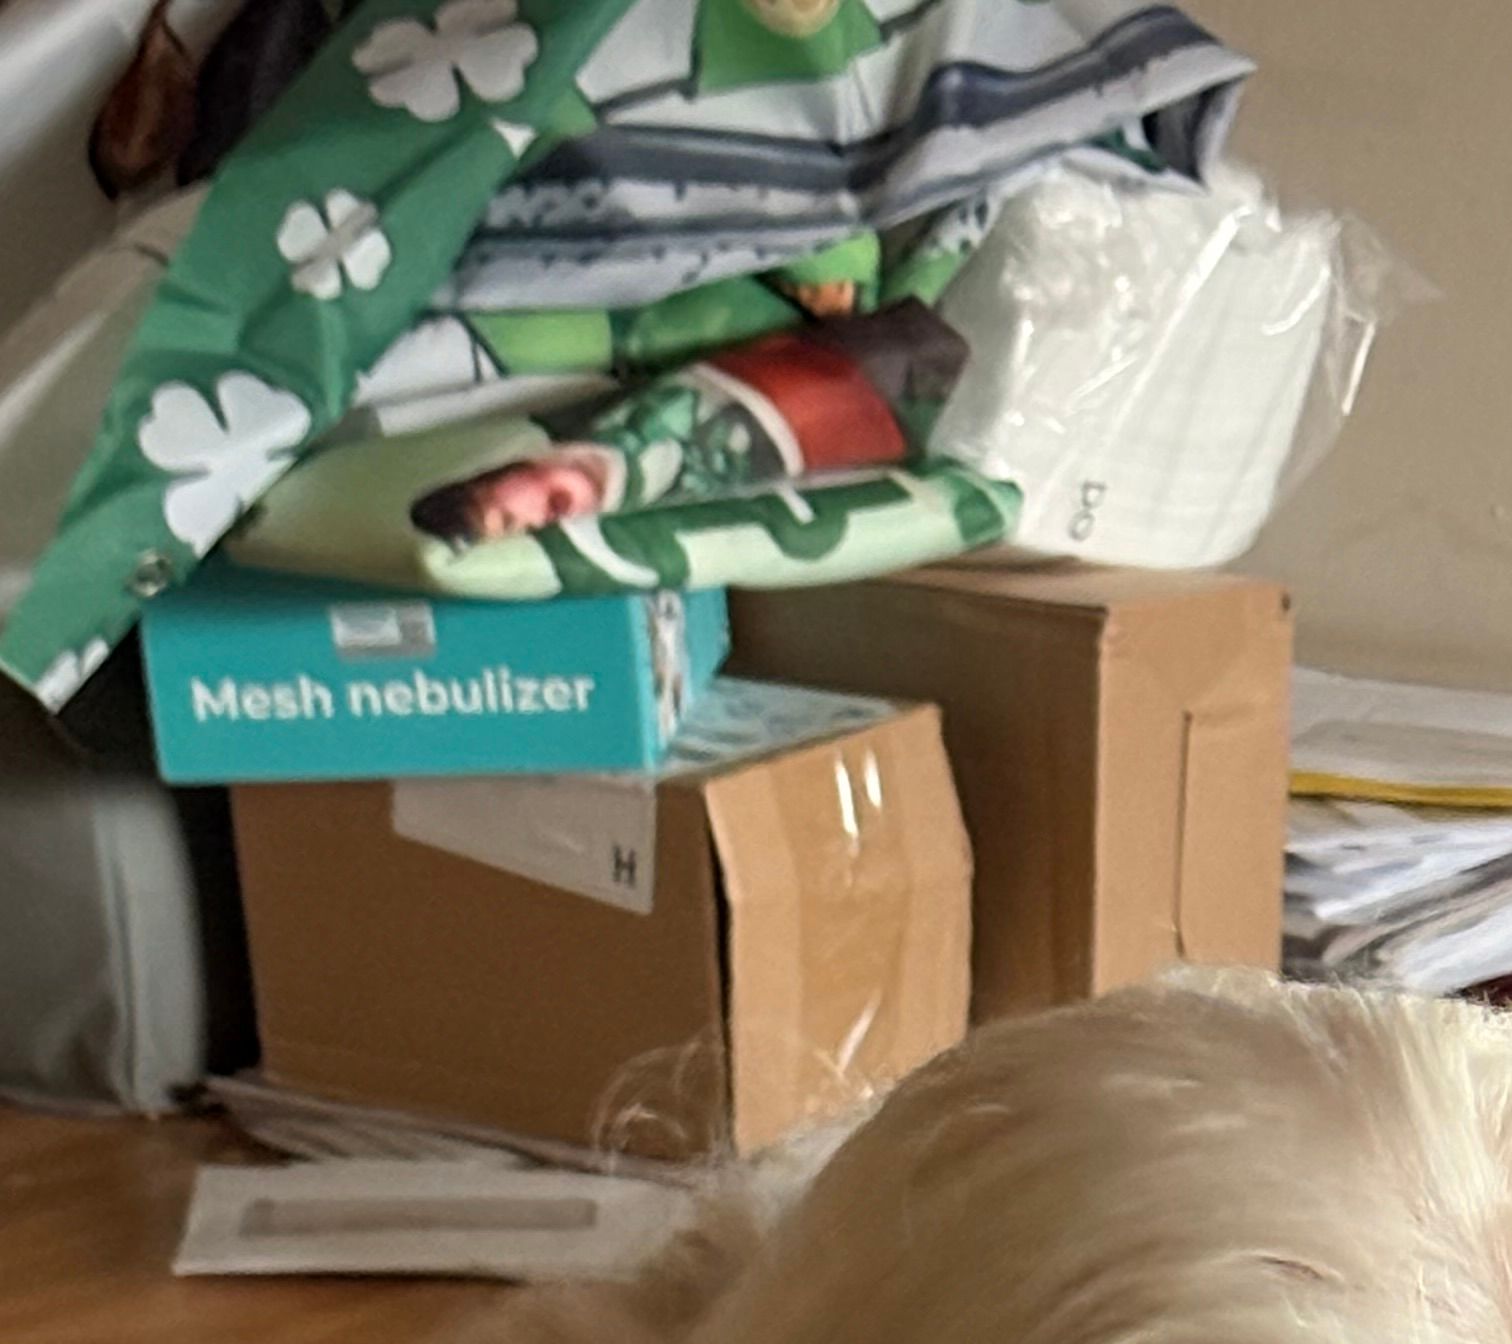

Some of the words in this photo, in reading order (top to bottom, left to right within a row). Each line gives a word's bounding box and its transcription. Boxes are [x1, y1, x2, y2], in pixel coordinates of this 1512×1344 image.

[191, 674, 335, 722] Mesh
[346, 664, 596, 717] nebulizer
[611, 845, 638, 889] H
